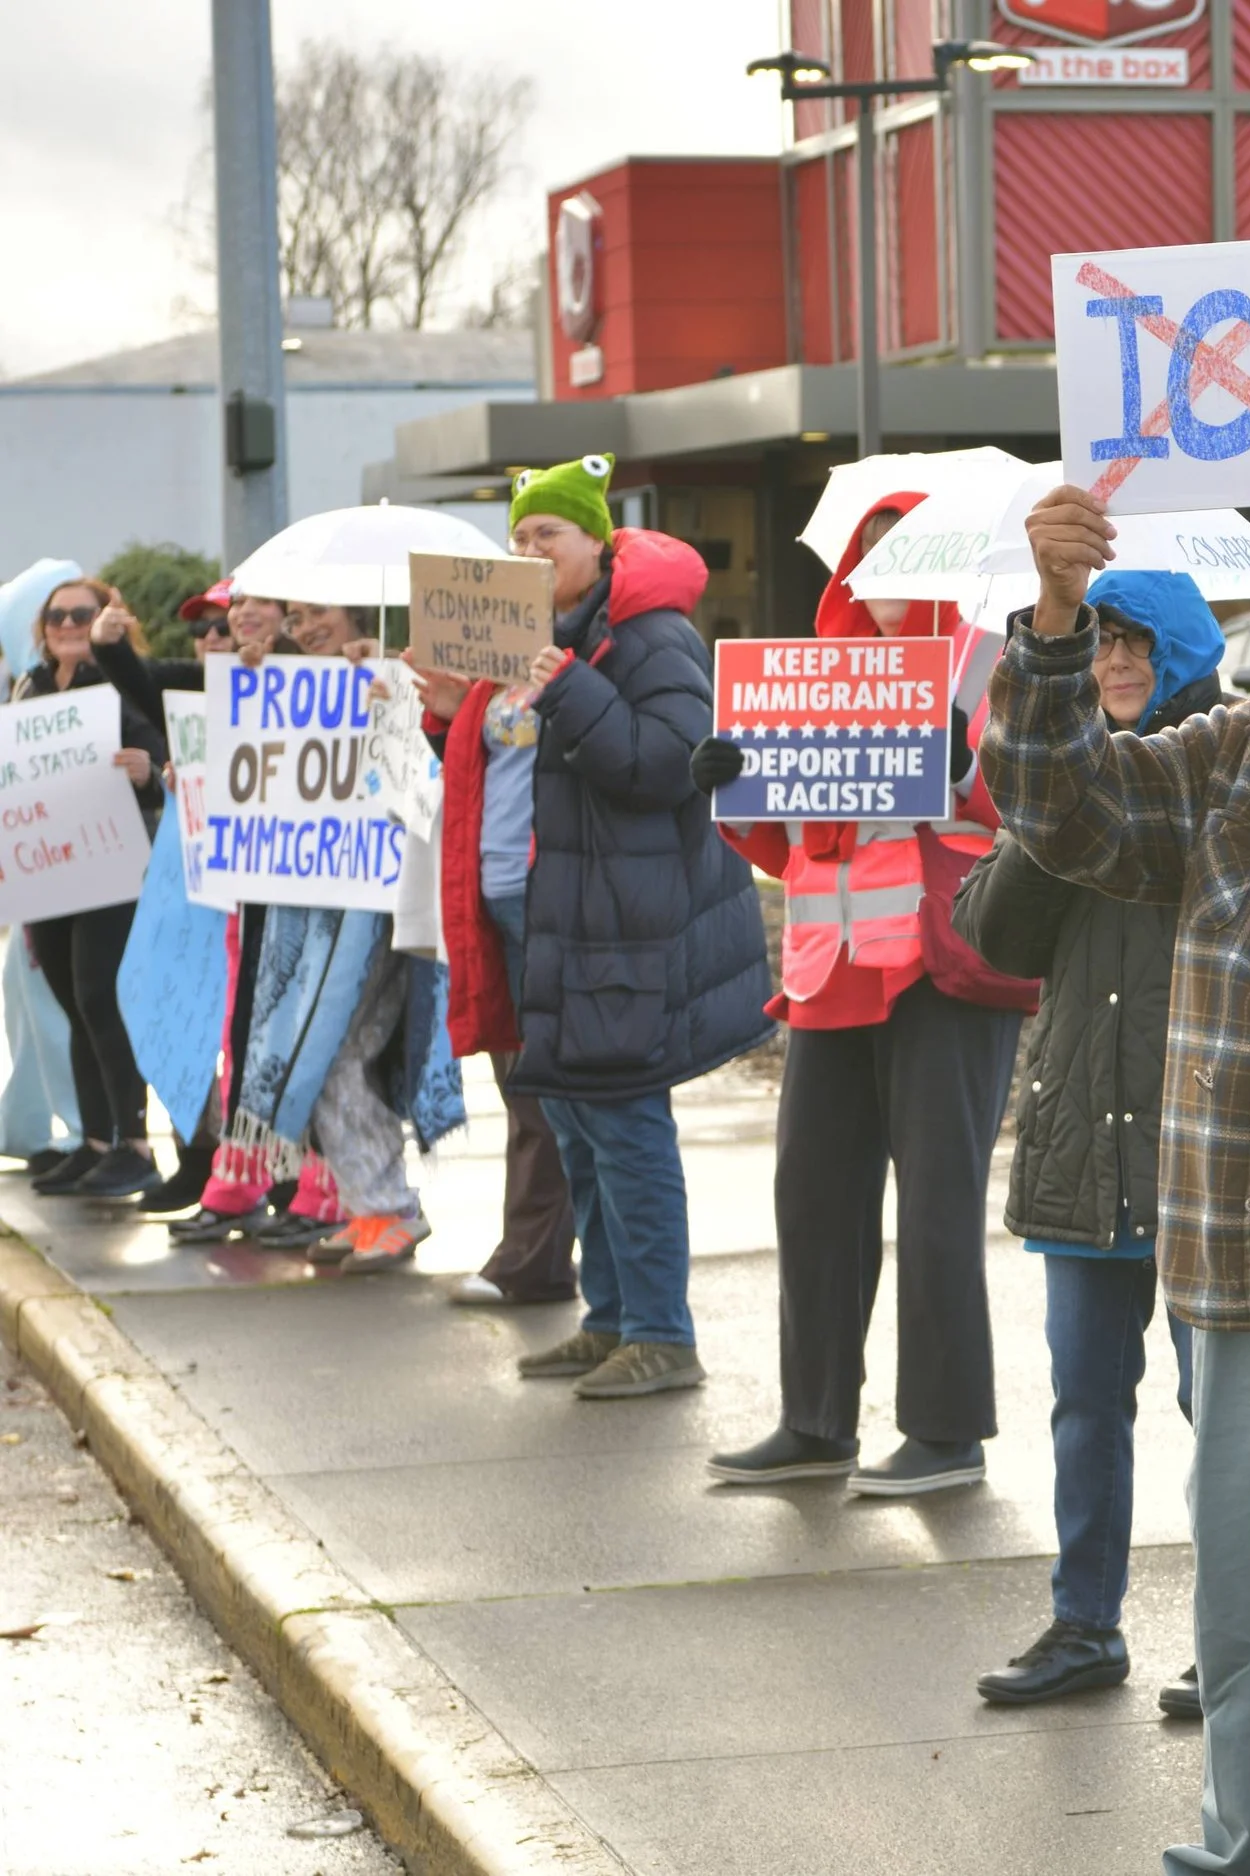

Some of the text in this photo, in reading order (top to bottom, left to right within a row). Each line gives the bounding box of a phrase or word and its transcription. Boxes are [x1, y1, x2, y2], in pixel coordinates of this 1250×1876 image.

[1061, 54, 1114, 79] the
[1123, 55, 1180, 79] box
[451, 558, 494, 583] STOP
[873, 531, 990, 576] SCARED
[423, 588, 536, 632] KIDNAPPING
[462, 623, 493, 641] OUR
[432, 640, 531, 681] NEIGHBORS
[763, 646, 904, 677] KEEP THE
[230, 666, 376, 730] PROUD
[732, 681, 934, 712] IMMIGRANTS
[16, 705, 83, 744] NEVER
[29, 743, 98, 781] STATUS
[229, 740, 285, 804] OF
[299, 738, 367, 802] OU
[739, 747, 923, 777] DEPORT THE
[767, 782, 895, 812] RACISTS
[206, 815, 407, 886] IMMIGRANTS
